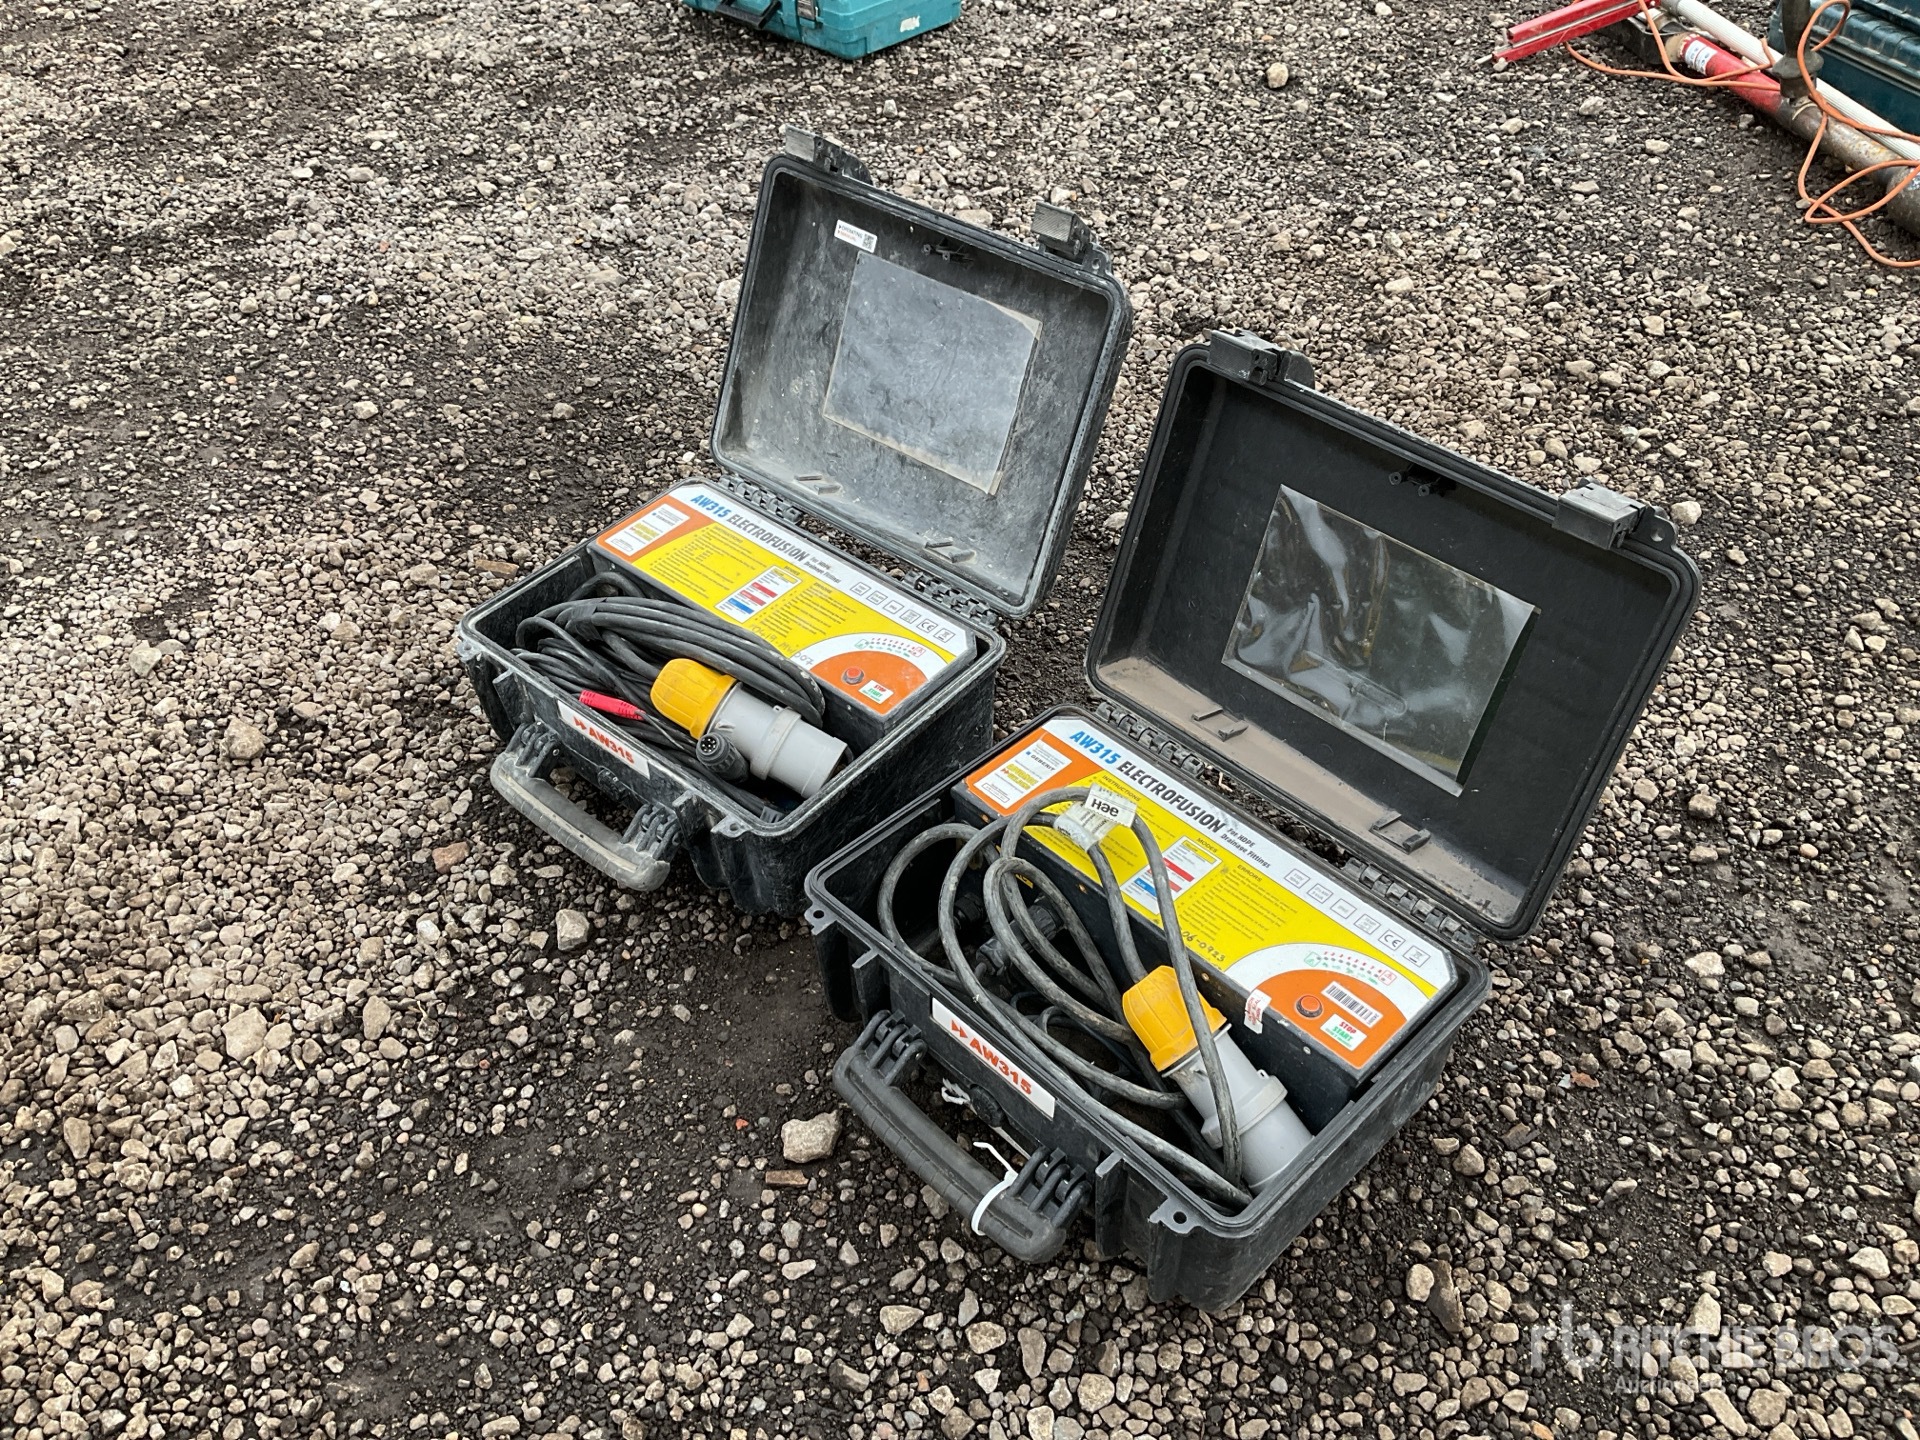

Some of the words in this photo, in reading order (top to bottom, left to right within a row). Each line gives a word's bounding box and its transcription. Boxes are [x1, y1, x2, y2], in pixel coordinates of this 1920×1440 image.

[690, 494, 732, 518] AW315
[727, 513, 811, 562] ELECTROFUSION
[588, 727, 634, 764] AW315
[1030, 754, 1056, 772] GEBERIT
[1070, 730, 1122, 765] AW315
[1116, 760, 1227, 834] ELECTROFUSION
[1102, 775, 1141, 802] INSTRUCTIONS
[1196, 837, 1218, 853] MODES
[1227, 828, 1239, 837] For
[1237, 834, 1256, 848] HDPE
[1220, 833, 1247, 854] Drainage
[1246, 850, 1271, 869] Fittings
[1237, 864, 1262, 882] ERRORS
[1332, 1025, 1353, 1042] START
[1338, 1021, 1357, 1035] STOP
[969, 1037, 1032, 1095] AW315
